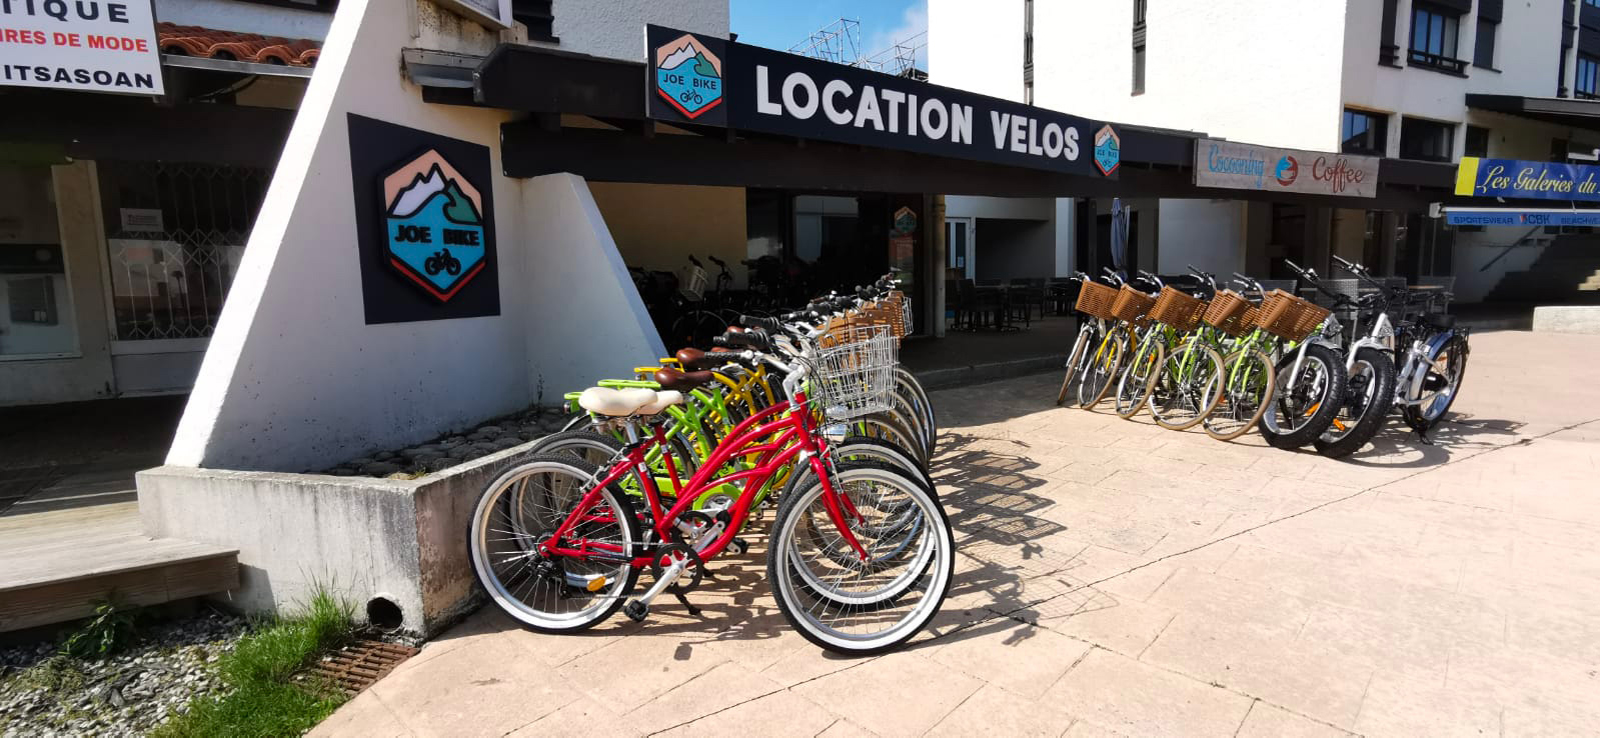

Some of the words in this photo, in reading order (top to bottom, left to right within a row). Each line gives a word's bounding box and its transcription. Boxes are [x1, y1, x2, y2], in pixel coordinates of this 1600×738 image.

[53, 32, 81, 47] DE
[88, 35, 148, 52] MODE
[4, 64, 154, 88] ITSASOAN
[663, 73, 685, 85] JOE
[692, 78, 717, 90] BIKE
[756, 65, 973, 145] LOCATION
[990, 110, 1080, 161] VELOS
[1208, 143, 1265, 189] Cocooning
[1312, 156, 1364, 194] Coffee
[1476, 165, 1510, 194] Les
[1513, 167, 1573, 192] Galeries
[1578, 172, 1597, 194] du
[1453, 216, 1514, 225] SPORTSWEAR
[395, 224, 432, 243] JOE
[443, 228, 480, 245] BIKE
